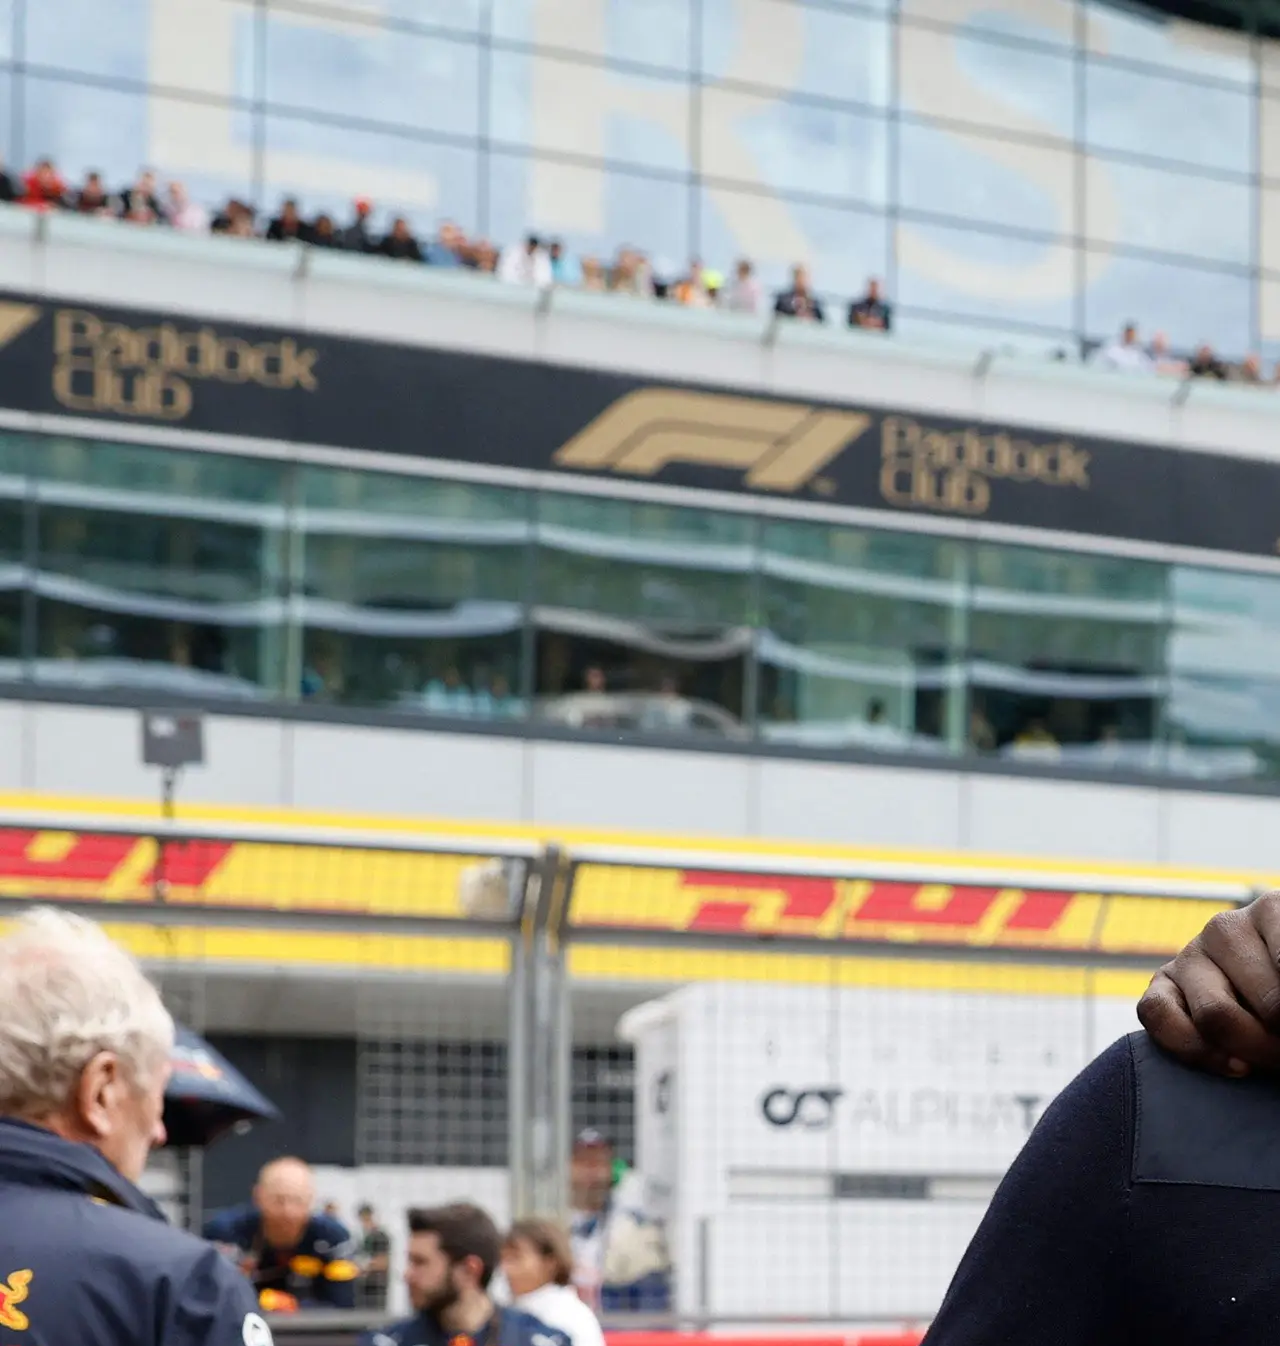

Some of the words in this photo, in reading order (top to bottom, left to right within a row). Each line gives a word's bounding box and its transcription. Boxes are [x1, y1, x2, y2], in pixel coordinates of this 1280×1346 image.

[53, 308, 321, 392] Paddock
[52, 362, 193, 420] Club
[879, 416, 1092, 490] Paddock
[879, 466, 990, 517] Club
